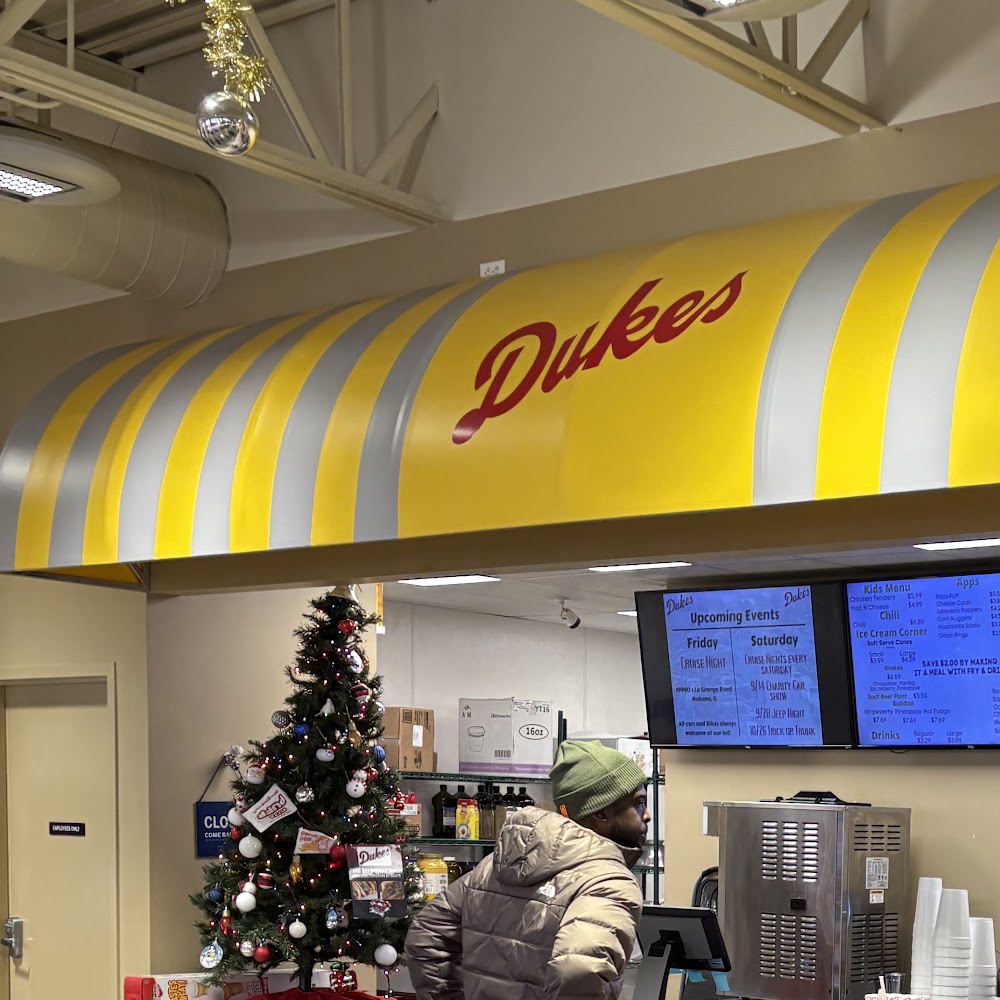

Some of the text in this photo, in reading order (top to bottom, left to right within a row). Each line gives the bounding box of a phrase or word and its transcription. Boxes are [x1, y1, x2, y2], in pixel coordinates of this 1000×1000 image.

[452, 269, 749, 444] Dukes
[864, 584, 910, 594] Kids Menu
[957, 578, 979, 588] Apps
[784, 588, 810, 607] Dukes
[667, 594, 693, 615] Dukes
[691, 609, 779, 626] Upcoming Events
[880, 610, 900, 620] Chili
[870, 629, 896, 638] Cream
[899, 628, 927, 636] Corner
[687, 637, 718, 650] Friday
[751, 634, 798, 647] Saturday
[872, 731, 900, 740] Drinks
[359, 848, 389, 865] Dukes
